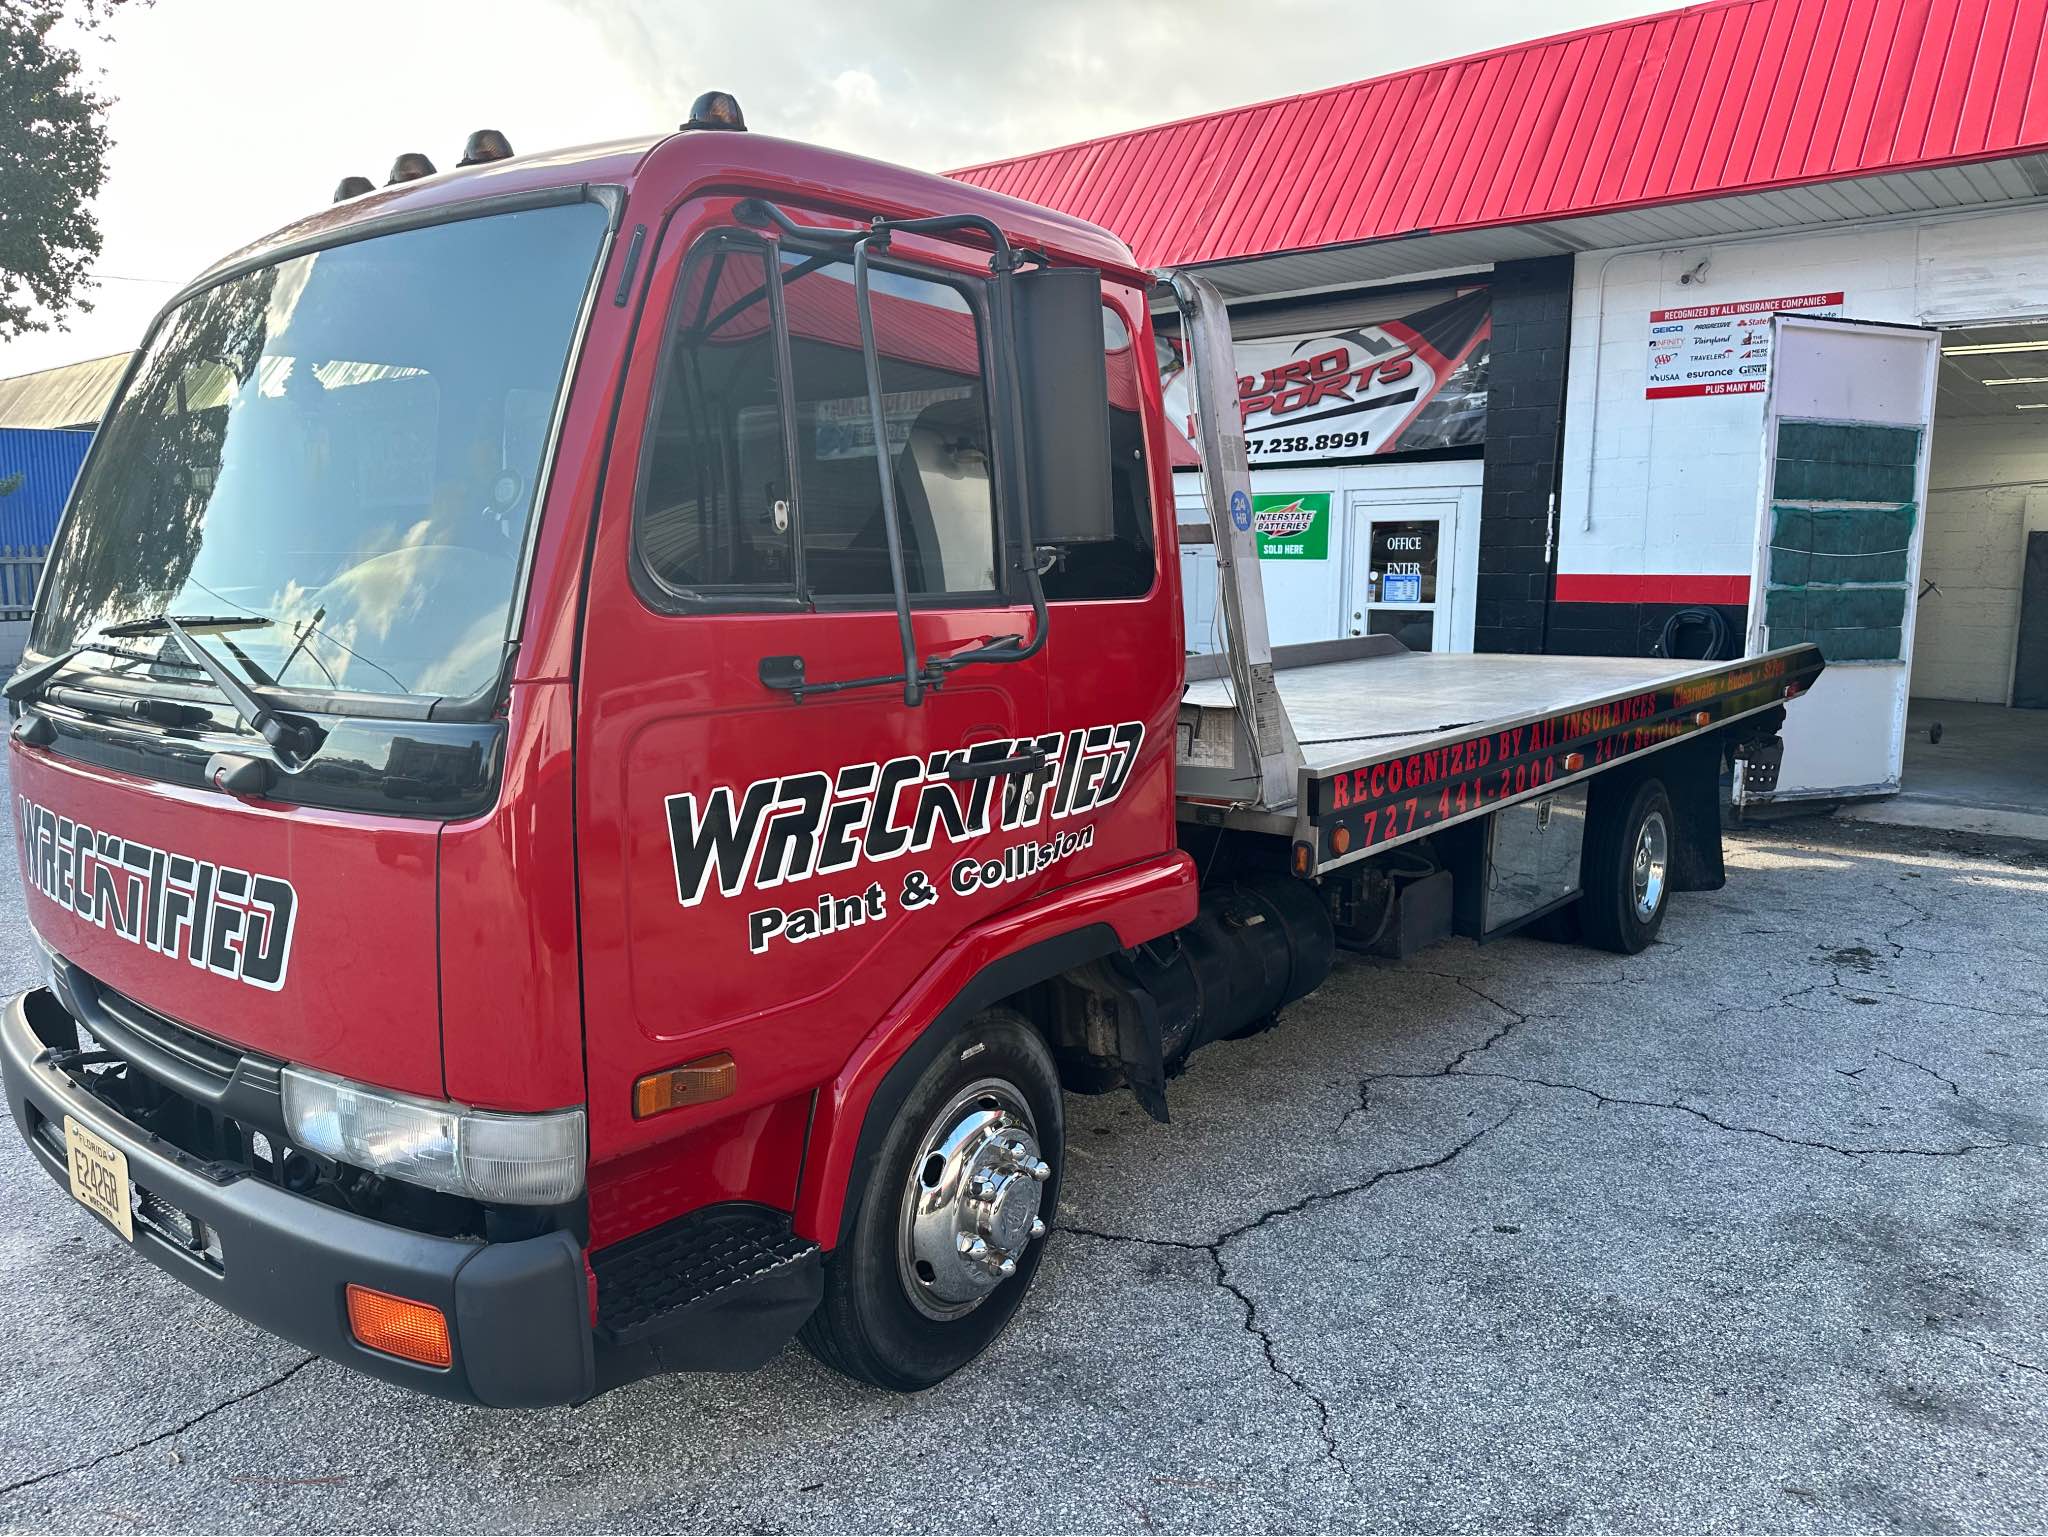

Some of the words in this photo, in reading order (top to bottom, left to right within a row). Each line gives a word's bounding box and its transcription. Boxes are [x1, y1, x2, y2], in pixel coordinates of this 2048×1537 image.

[1664, 307, 1708, 320] RECOGNIZED
[1710, 307, 1719, 316] BY
[1721, 305, 1734, 315] ALL
[1737, 301, 1779, 313] INSURANCE
[1781, 295, 1827, 309] COMPANIES
[1652, 325, 1684, 334] GEICO
[1692, 335, 1733, 346] Dairyland
[1689, 353, 1726, 362] TRAVELERS
[1236, 347, 1349, 400] URO
[1659, 374, 1680, 382] USAA
[1686, 368, 1733, 379] esurance
[1240, 350, 1416, 426] PORTS
[1705, 384, 1725, 394] PLUS
[1726, 382, 1747, 393] MANY
[1749, 381, 1766, 391] MOR
[1244, 431, 1369, 454] 27.238.8991
[1234, 498, 1246, 511] 24
[1236, 512, 1248, 525] HR
[1256, 512, 1312, 522] INTERSTATE
[1257, 521, 1308, 531] BATTERIES
[1263, 544, 1283, 555] SOLD
[1284, 544, 1304, 555] HERE
[1387, 537, 1421, 550] OFFICE
[1387, 562, 1421, 575] ENTER
[1332, 737, 1491, 810] RECOGNIZED
[1499, 727, 1524, 760] BY
[1562, 692, 1657, 742] INSURANCES
[1363, 756, 1555, 848] 727-441-2000
[1594, 731, 1629, 764] 24/7
[1634, 717, 1683, 750] Service
[664, 720, 1146, 908] WRECKTIFIED
[19, 794, 299, 992] WRECKTIFIED
[748, 881, 887, 956] Paint
[899, 870, 940, 911] &
[950, 823, 1094, 896] Collision
[78, 1133, 107, 1161] FLORIDA
[74, 1147, 119, 1213] E2426B
[88, 1193, 114, 1220] WRECKER
